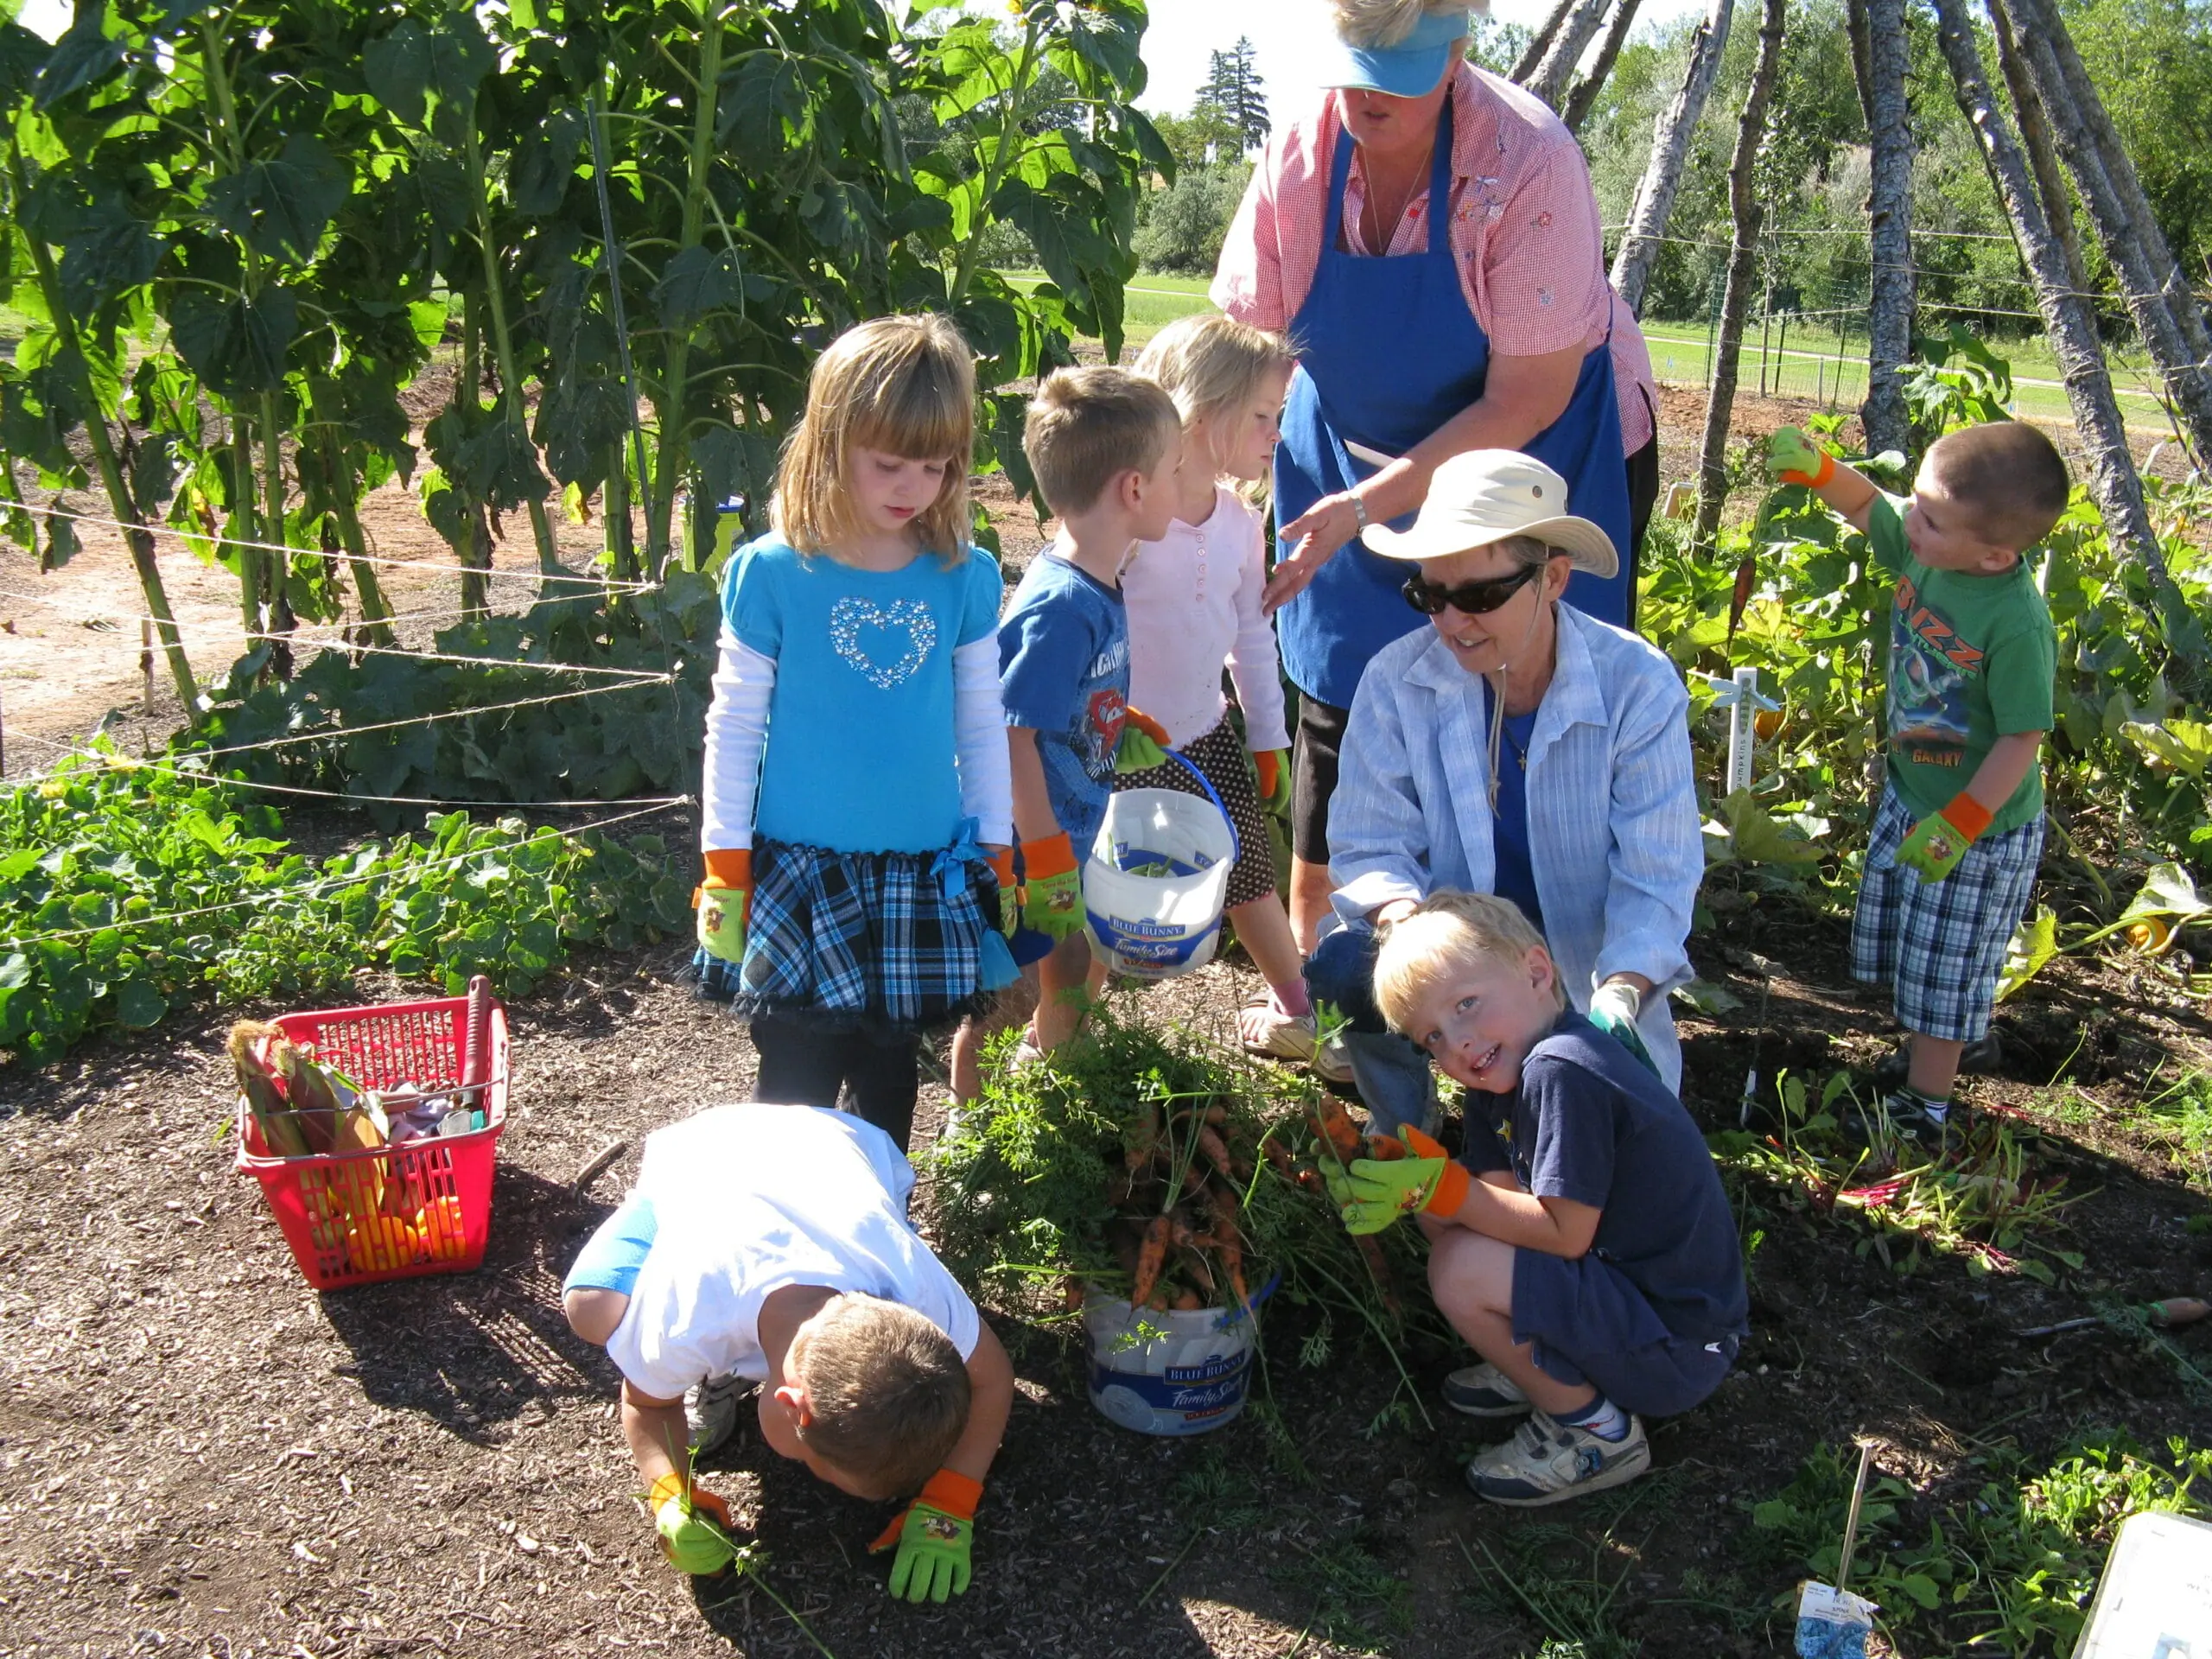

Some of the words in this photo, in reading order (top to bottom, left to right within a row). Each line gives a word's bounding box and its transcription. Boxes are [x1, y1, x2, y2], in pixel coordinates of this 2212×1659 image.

[1912, 750, 1962, 766] GALAXY
[1113, 918, 1139, 931] BLUE
[1142, 925, 1180, 937] BUNNY
[1151, 944, 1179, 958] Size
[1171, 1370, 1202, 1380] BLUE
[1173, 1389, 1216, 1407] Family
